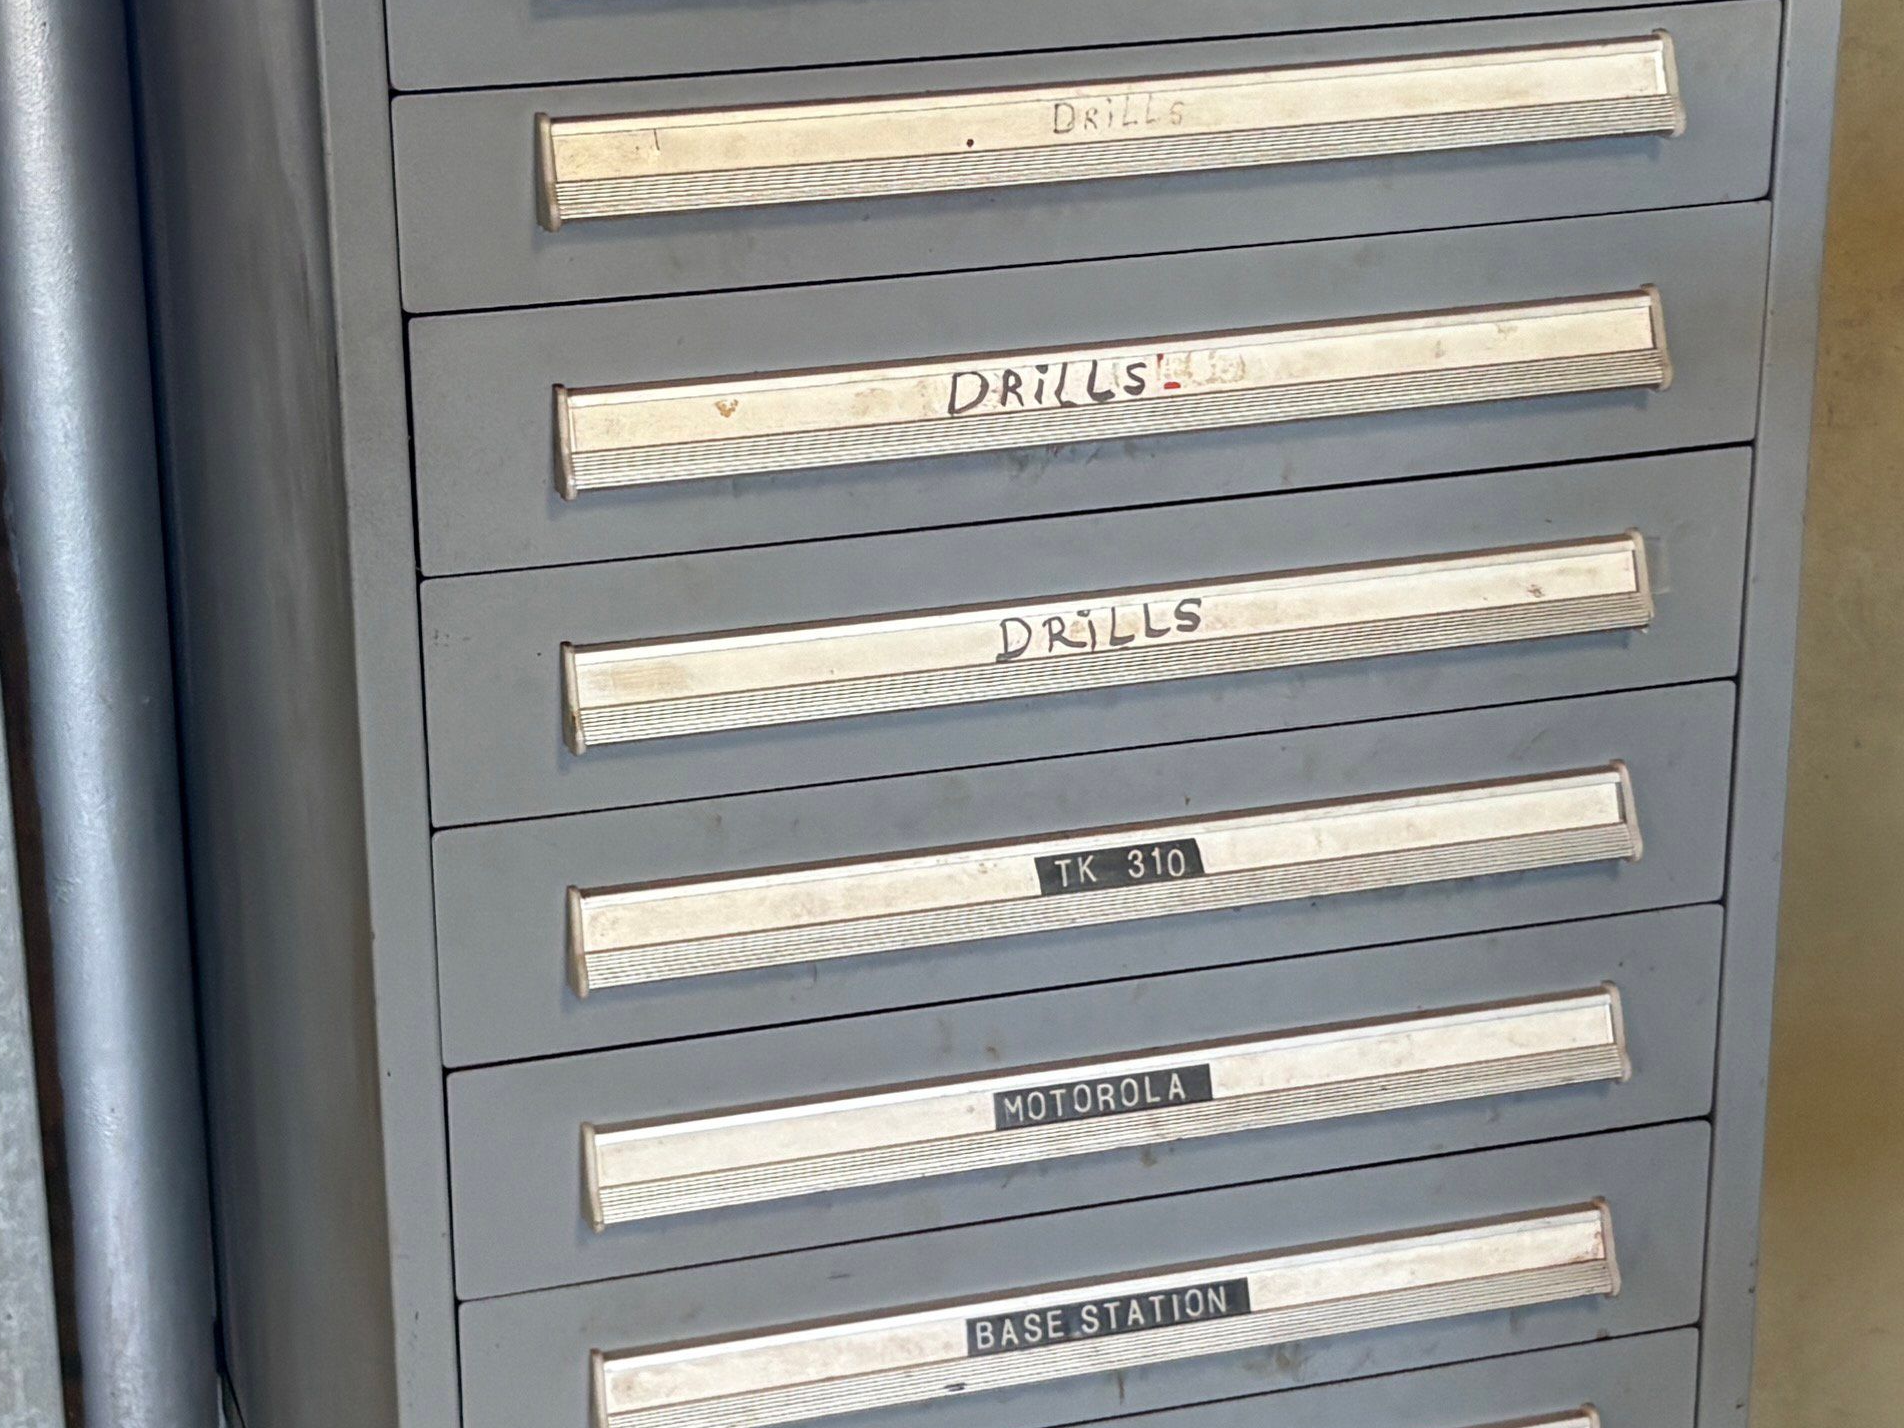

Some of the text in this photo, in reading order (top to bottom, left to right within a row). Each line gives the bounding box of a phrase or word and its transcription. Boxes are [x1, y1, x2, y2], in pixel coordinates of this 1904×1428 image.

[1054, 846, 1186, 888] TK 310
[1004, 1072, 1187, 1123] MOTOROLA
[975, 1284, 1228, 1350] BASE STATION
